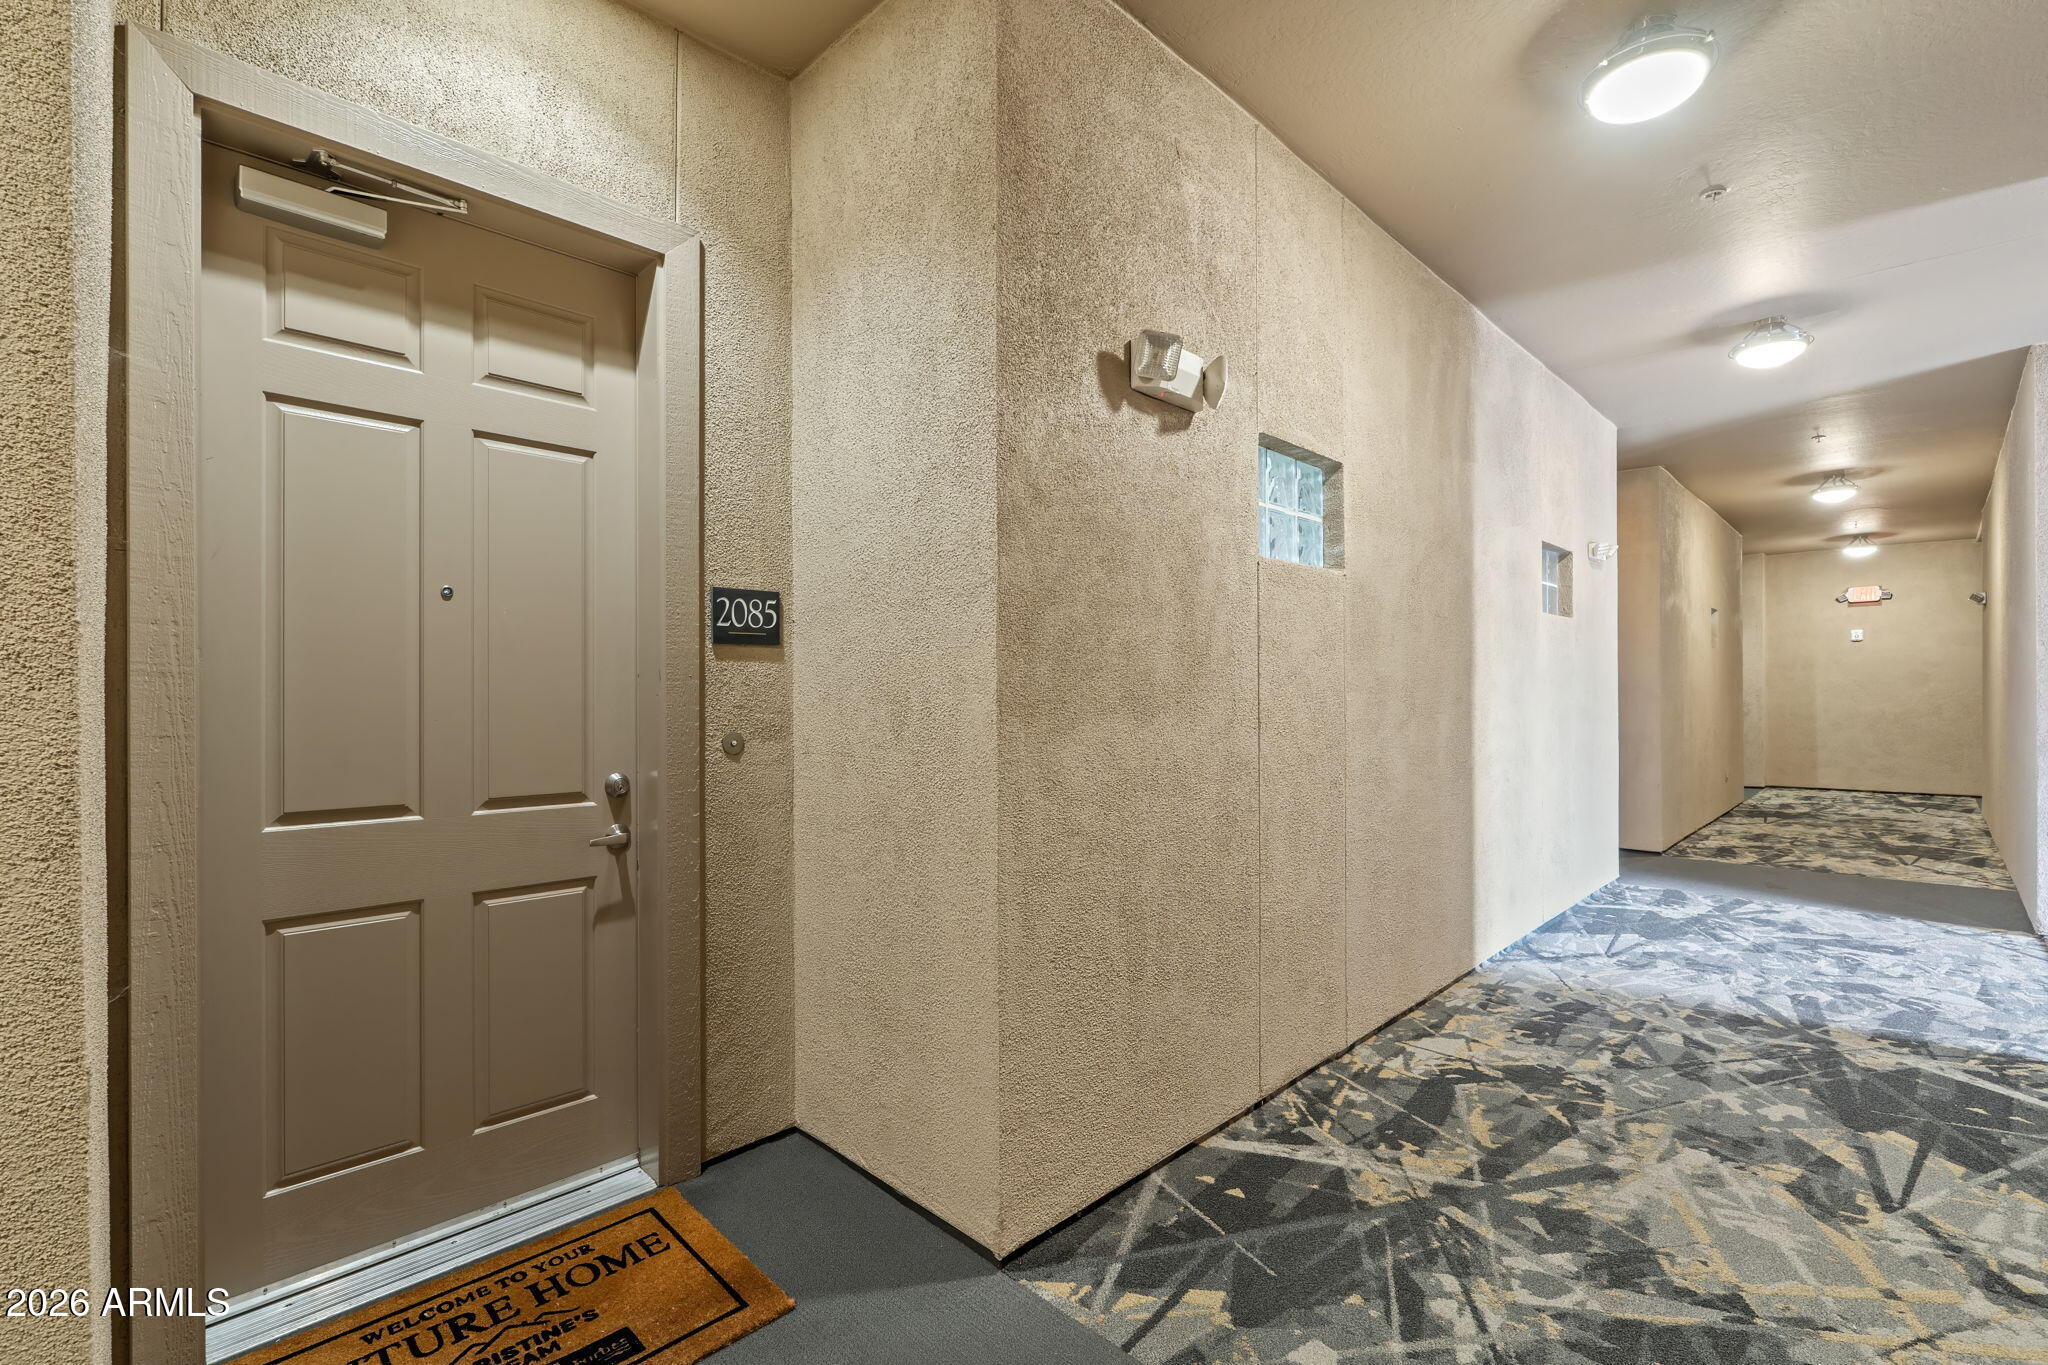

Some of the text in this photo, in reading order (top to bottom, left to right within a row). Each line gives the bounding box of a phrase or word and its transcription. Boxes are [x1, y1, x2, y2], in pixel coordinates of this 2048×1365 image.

[716, 597, 777, 628] 2085
[347, 1231, 670, 1365] TURE HOME
[360, 1243, 595, 1345] WELCOME TO YOUR
